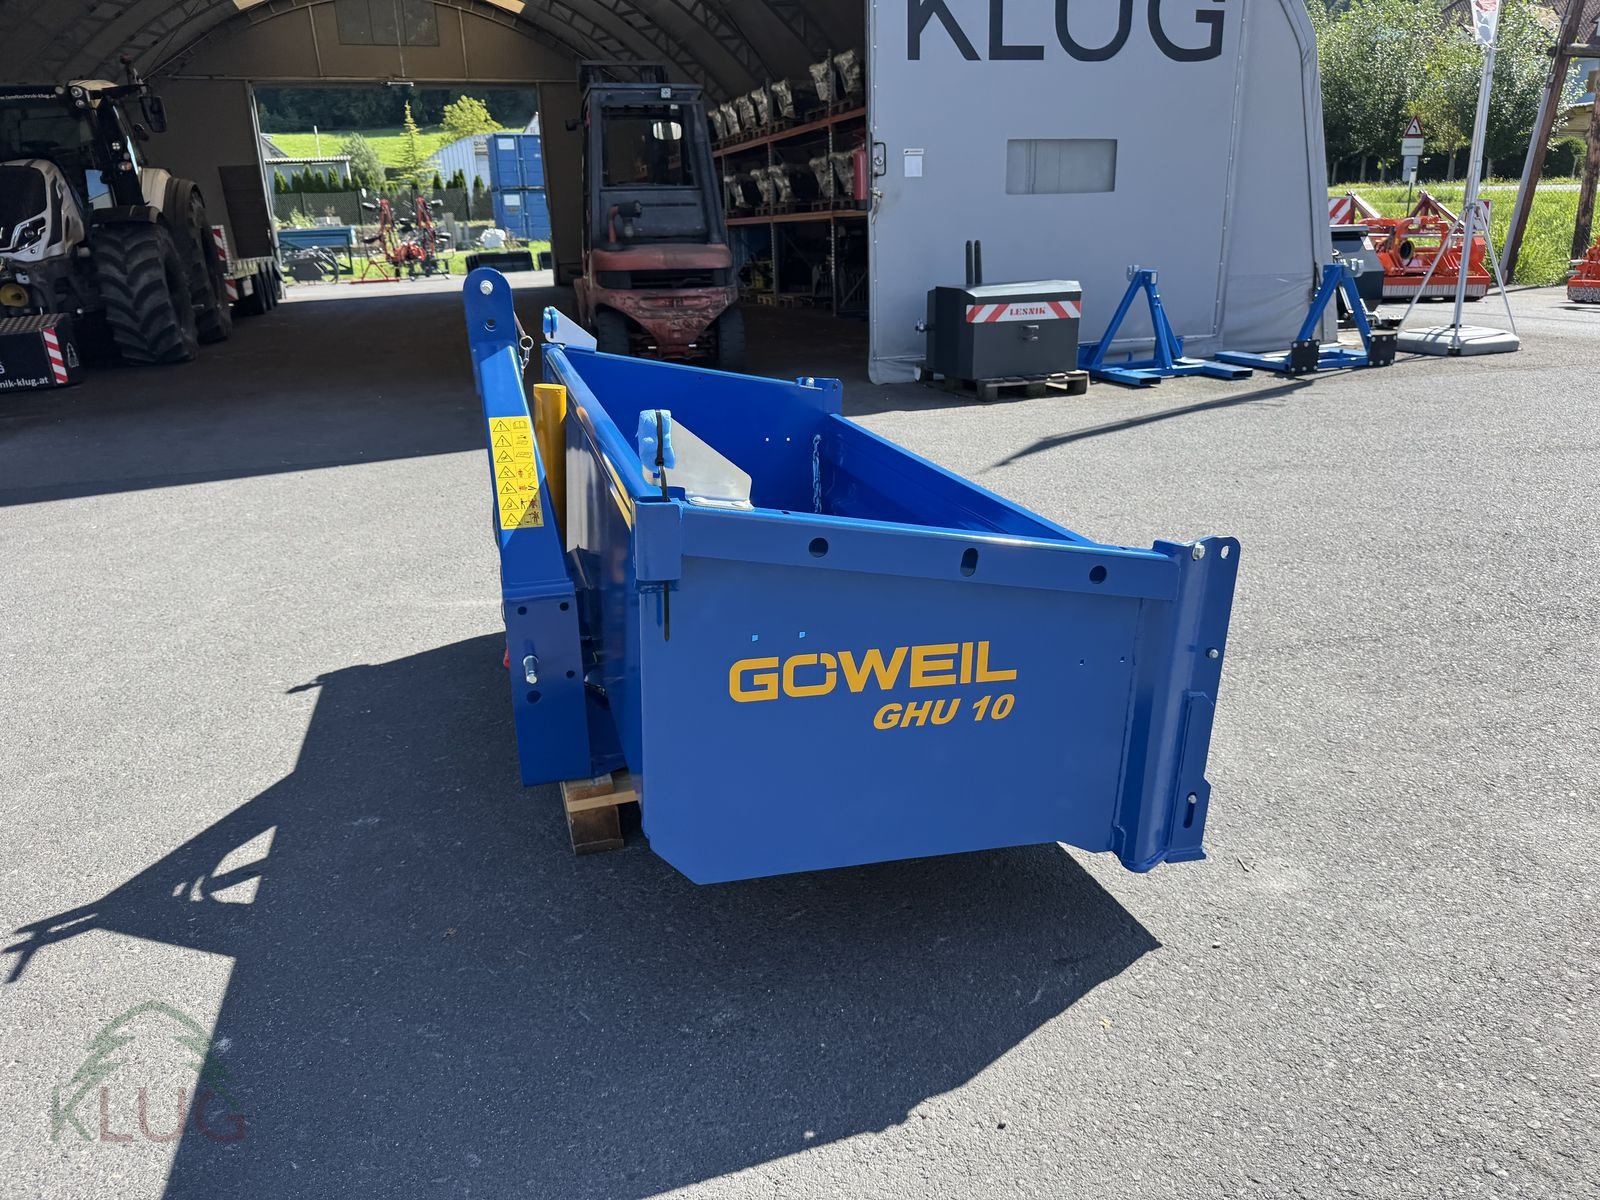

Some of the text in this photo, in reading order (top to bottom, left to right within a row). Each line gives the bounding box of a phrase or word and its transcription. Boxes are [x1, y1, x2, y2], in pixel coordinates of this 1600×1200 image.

[907, 0, 1225, 62] KLUG
[1009, 306, 1047, 317] LESNIK
[873, 693, 1015, 730] GHU 10
